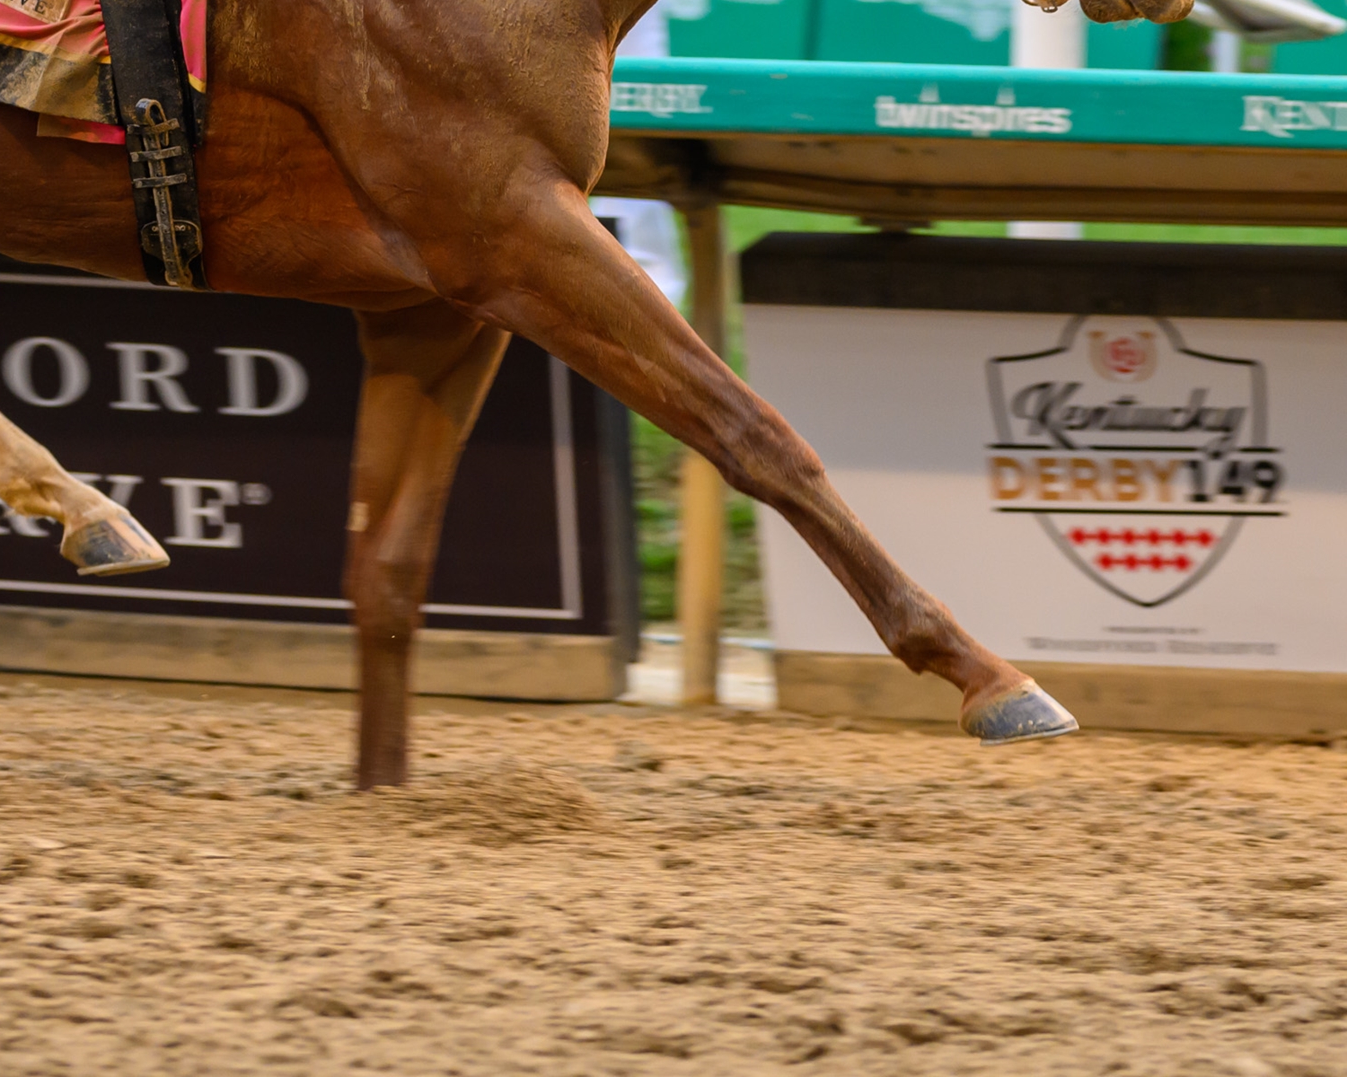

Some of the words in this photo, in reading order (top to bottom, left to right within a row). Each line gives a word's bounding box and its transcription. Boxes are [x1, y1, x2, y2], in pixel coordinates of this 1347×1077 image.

[610, 82, 713, 119] ERBY
[1011, 381, 1246, 460] Kentucky
[988, 456, 1181, 502] DERBY
[1183, 459, 1282, 504] 149
